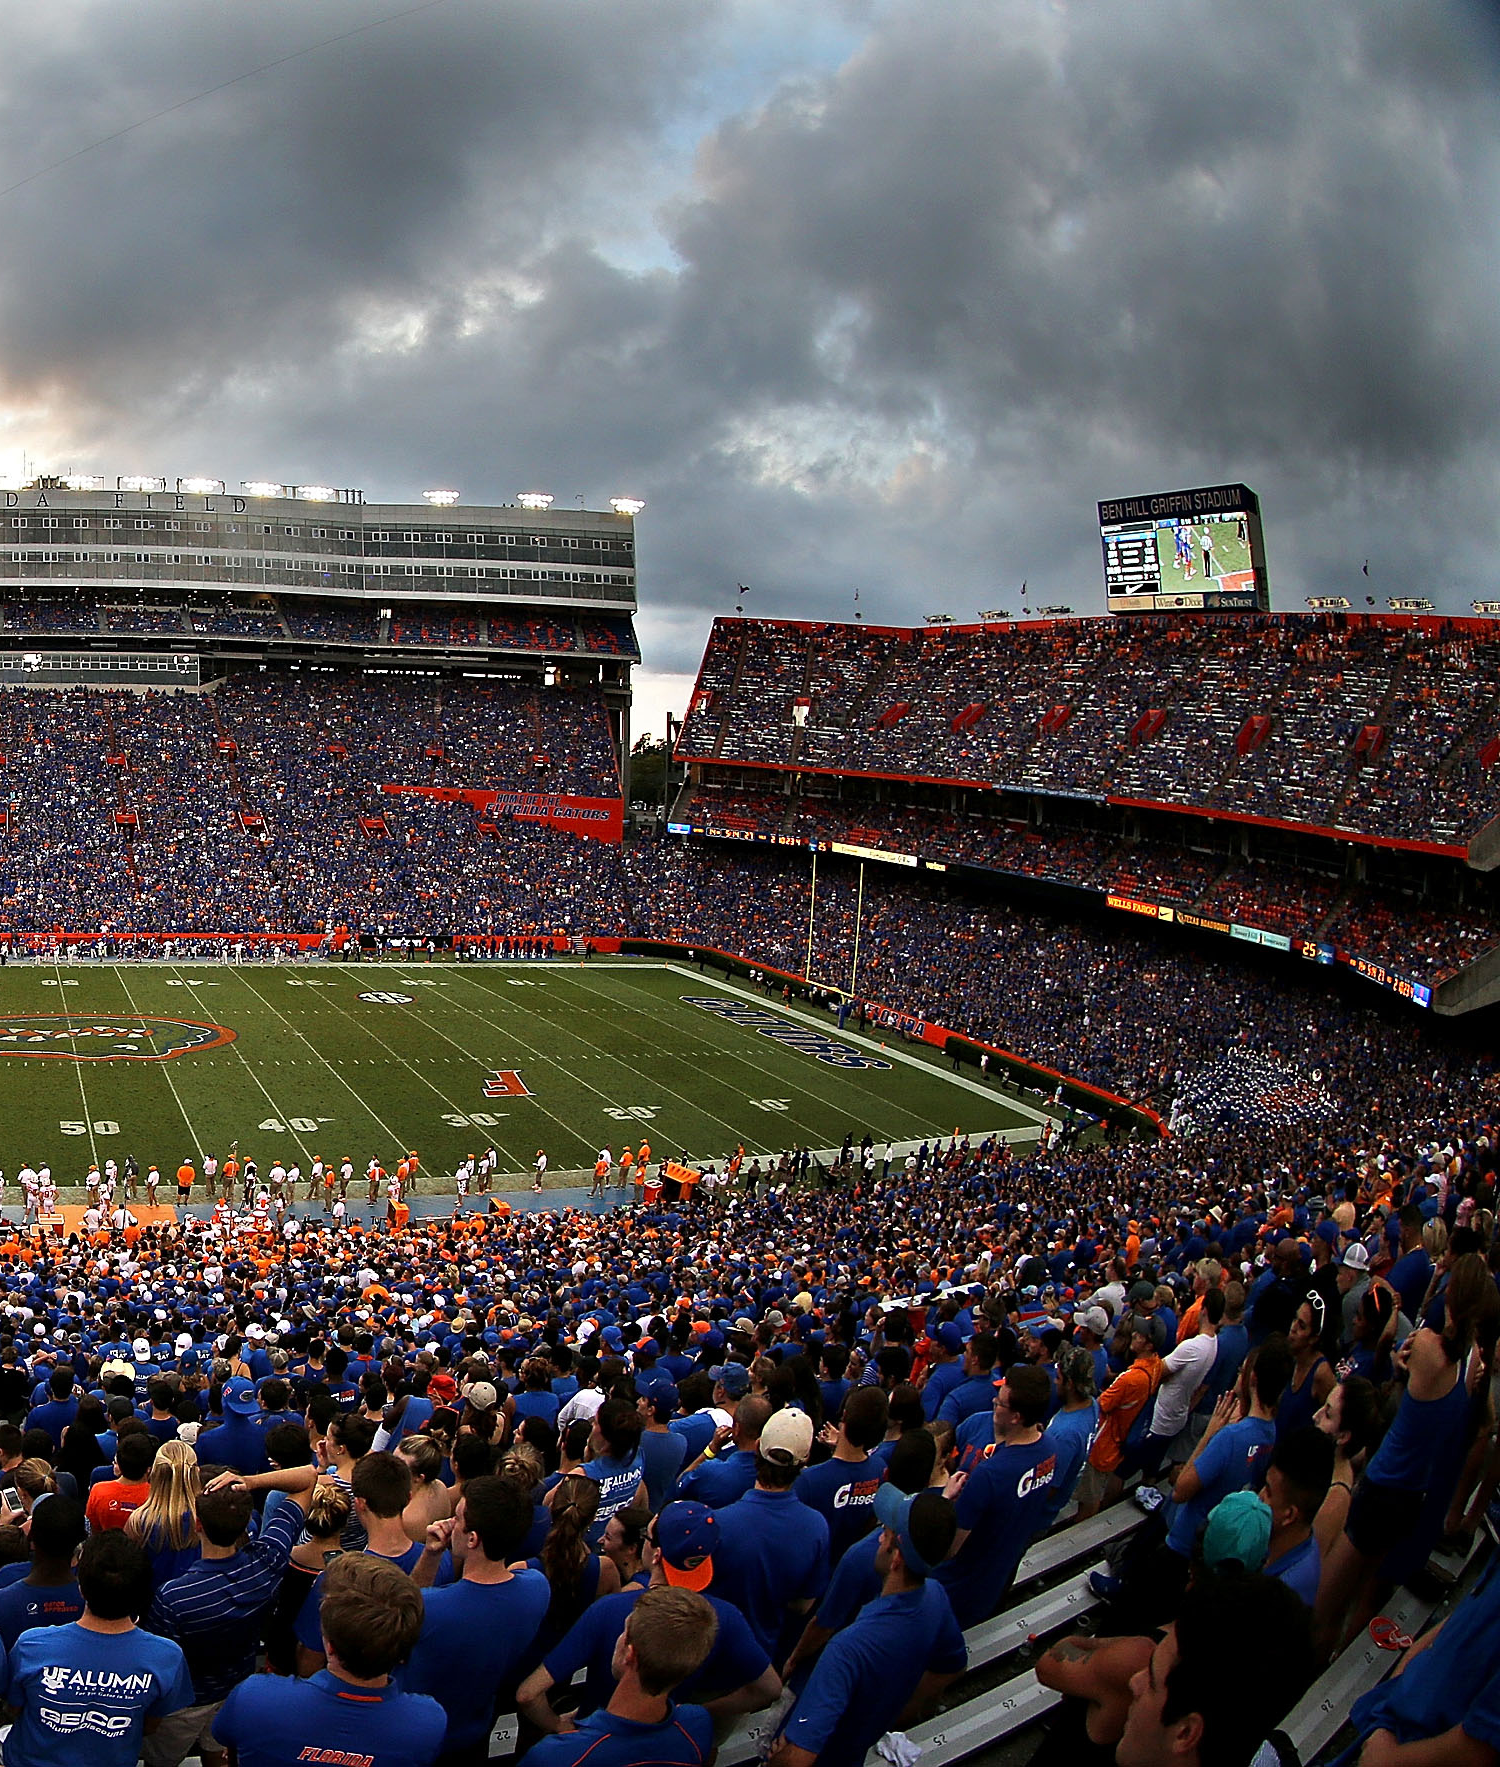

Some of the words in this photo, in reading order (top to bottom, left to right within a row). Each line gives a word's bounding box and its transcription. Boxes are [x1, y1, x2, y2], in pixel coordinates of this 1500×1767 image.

[114, 493, 246, 513] FIELD
[1102, 503, 1123, 520] BEN
[1126, 500, 1148, 517] HILL
[1151, 495, 1192, 514] GRIFFIN
[1194, 488, 1242, 510] STADIUM
[495, 793, 524, 804] HOME
[525, 794, 539, 805] OF
[540, 796, 563, 807] THE
[485, 803, 549, 817] FLORIDA
[552, 807, 611, 821] GATORS
[1107, 896, 1132, 910] WELLS
[1132, 902, 1157, 917] FARGO
[1302, 941, 1317, 957] 25
[602, 1106, 656, 1121] 20
[749, 1099, 786, 1112] 10
[59, 1120, 121, 1135] 50
[258, 1117, 318, 1133] 40
[440, 1112, 500, 1128] 30
[834, 1483, 852, 1509] G
[69, 1670, 153, 1692] ALUMNI
[68, 1685, 148, 1695] ASSOCIATION
[40, 1707, 131, 1731] GEICO
[495, 1730, 511, 1741] 22
[933, 1733, 947, 1746] 25
[297, 1746, 375, 1767] FLORIDA
